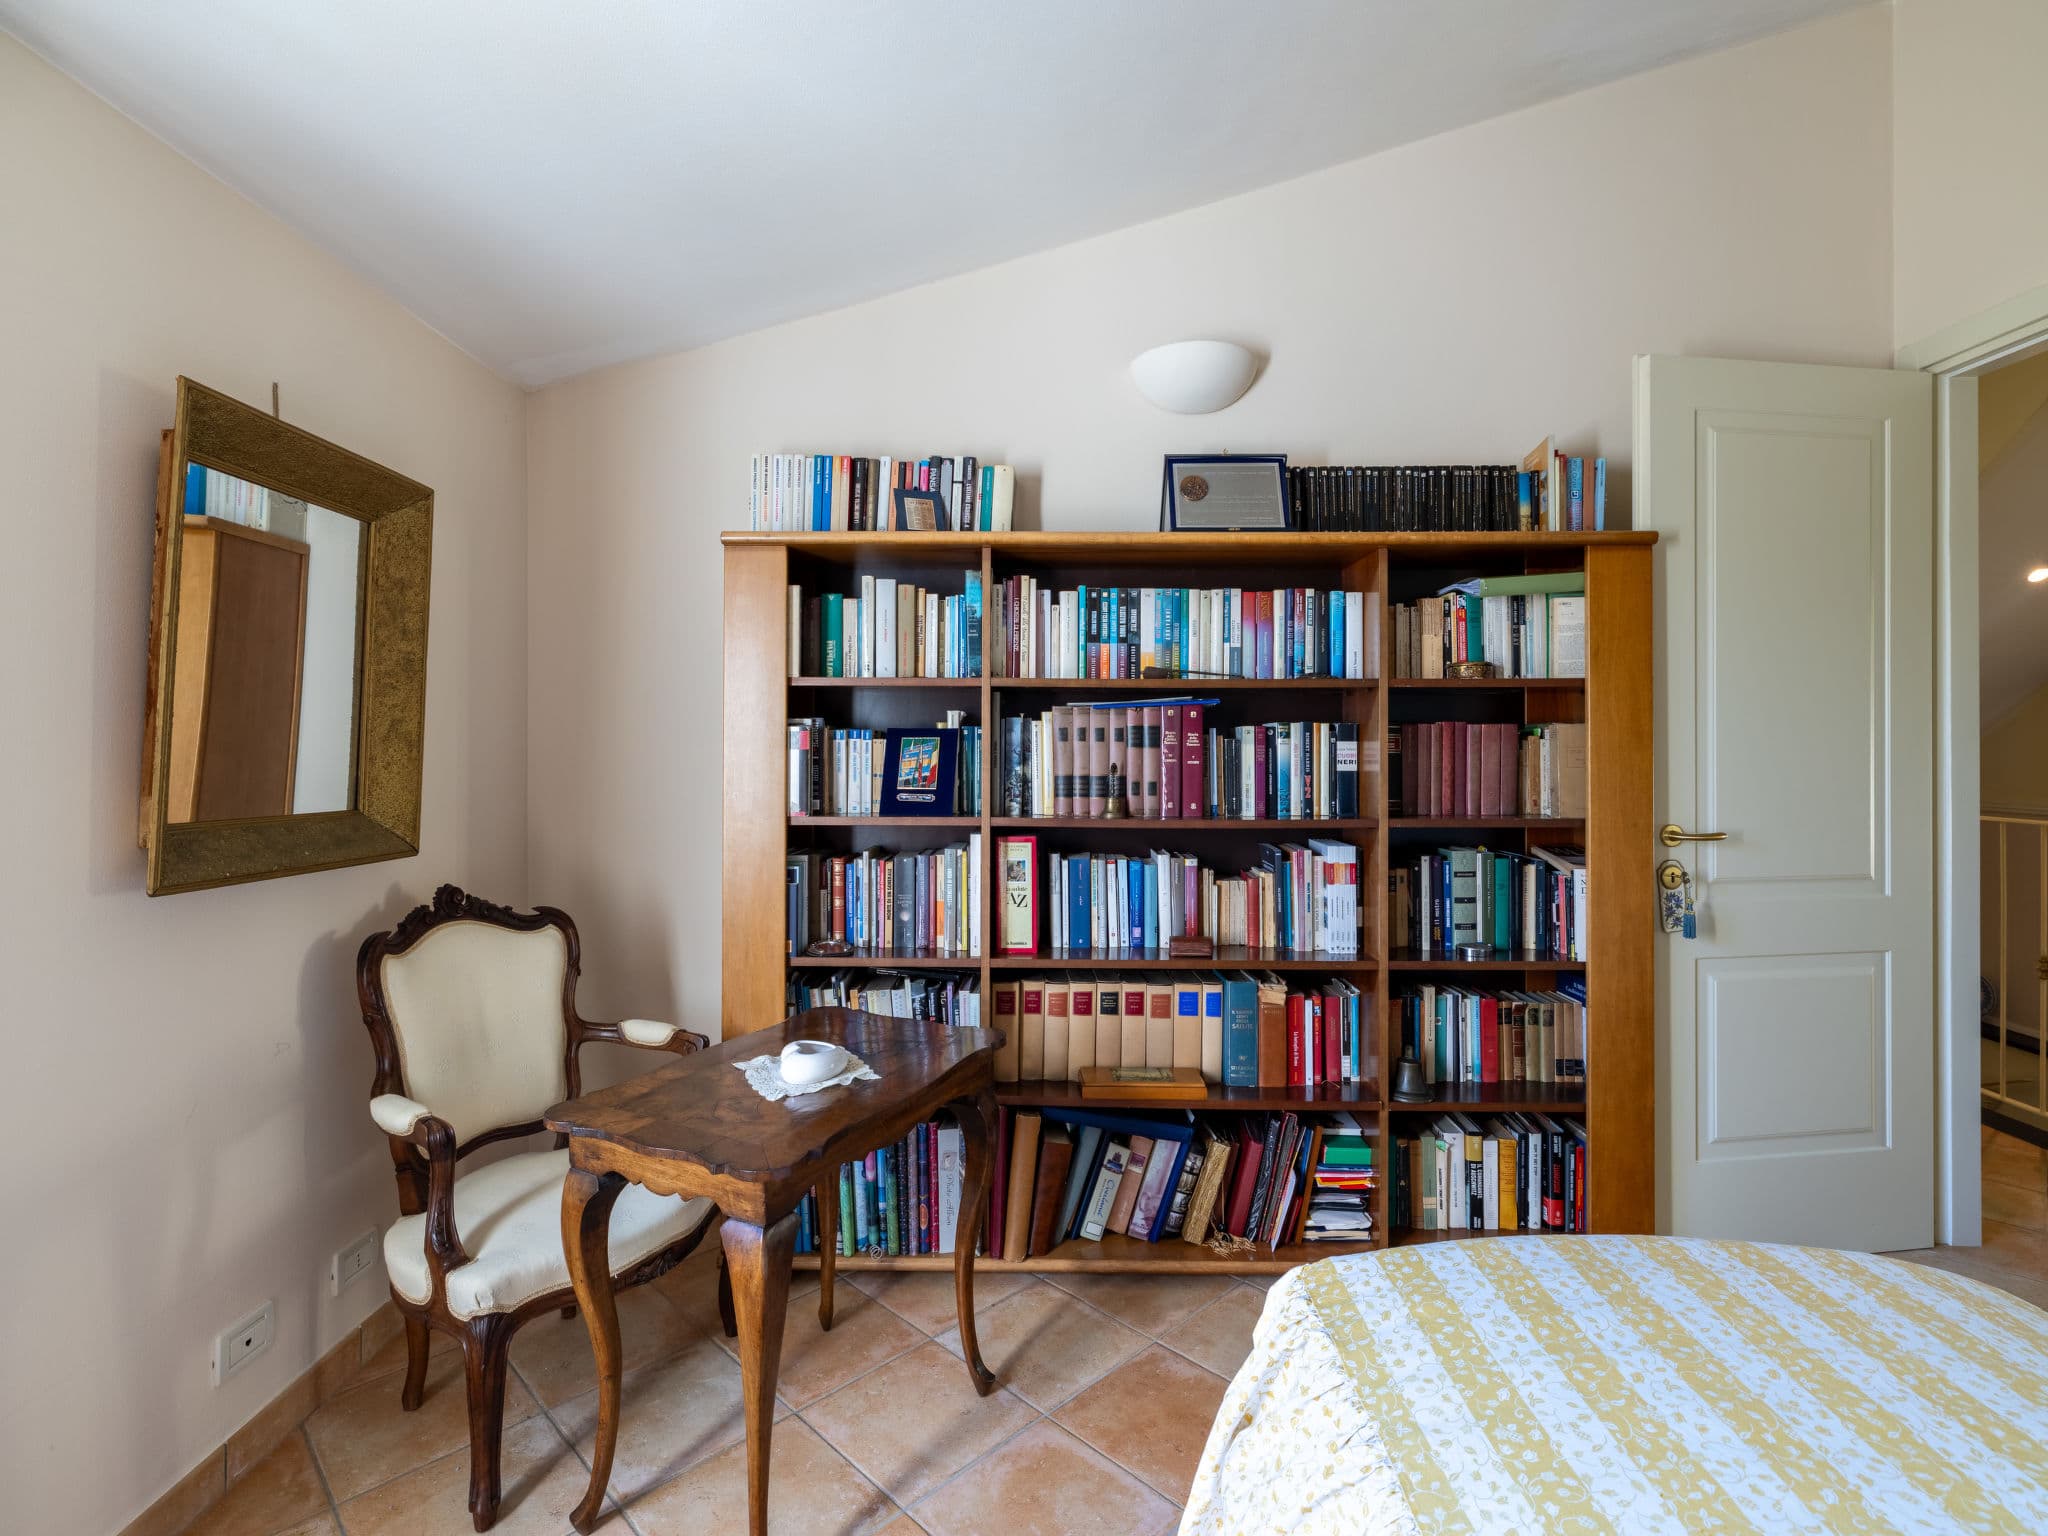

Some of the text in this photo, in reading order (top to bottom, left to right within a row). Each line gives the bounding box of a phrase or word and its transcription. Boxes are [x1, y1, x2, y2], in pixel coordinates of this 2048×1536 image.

[929, 467, 937, 492] PANSA
[946, 1175, 954, 1226] Photo Album
